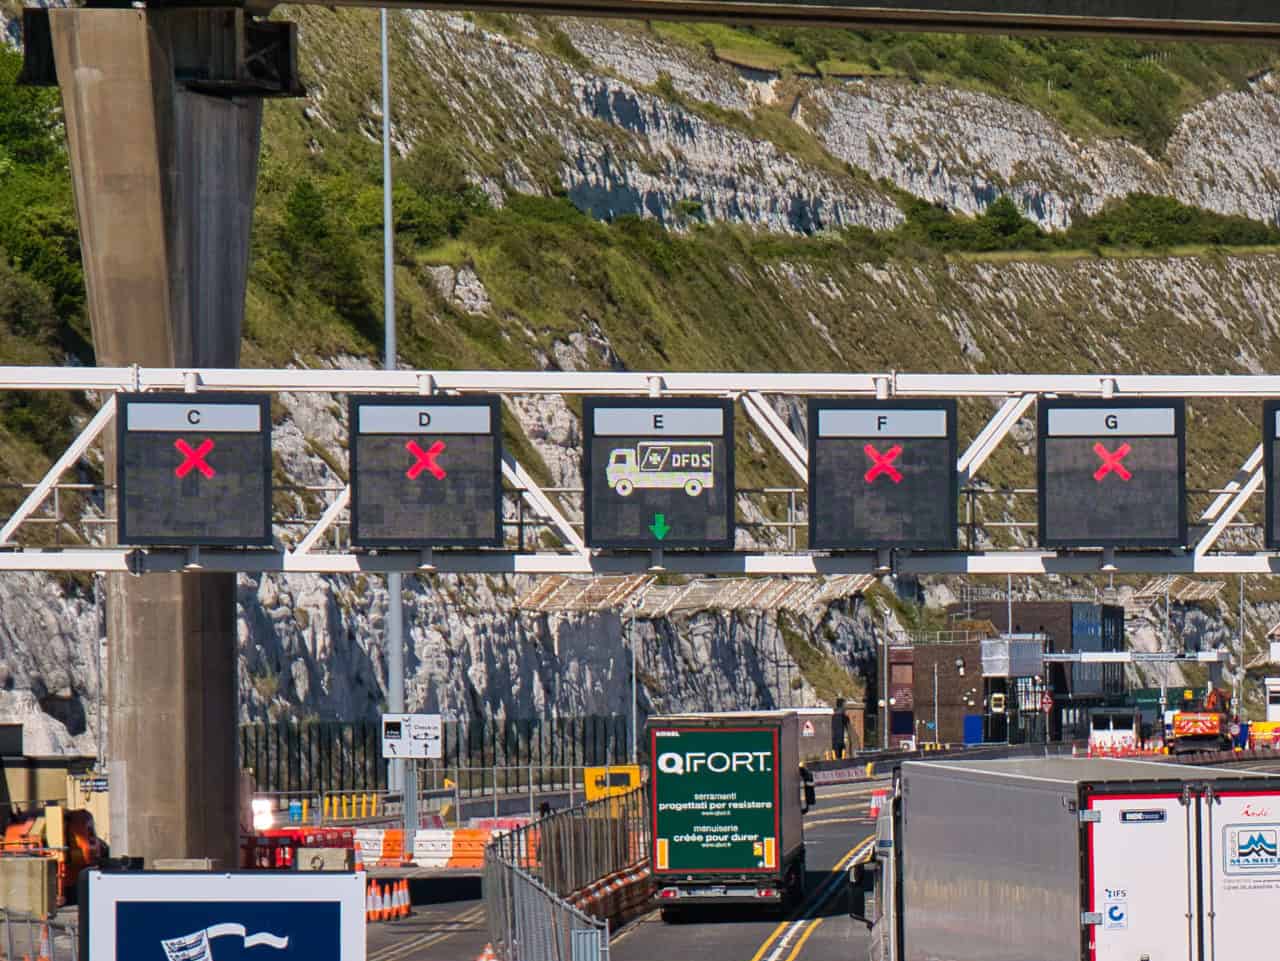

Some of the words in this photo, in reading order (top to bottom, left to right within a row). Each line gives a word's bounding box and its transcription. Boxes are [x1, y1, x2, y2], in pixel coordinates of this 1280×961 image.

[188, 410, 200, 425] C
[418, 412, 430, 427] D
[653, 414, 664, 429] E
[877, 415, 888, 430] F
[1104, 415, 1117, 430] G
[672, 454, 711, 467] DFDS
[694, 792, 736, 800] serramenti
[659, 801, 707, 811] progettati
[709, 802, 726, 810] per
[728, 800, 772, 809] resistere
[693, 824, 738, 832] menuiserie
[705, 834, 729, 843] pour
